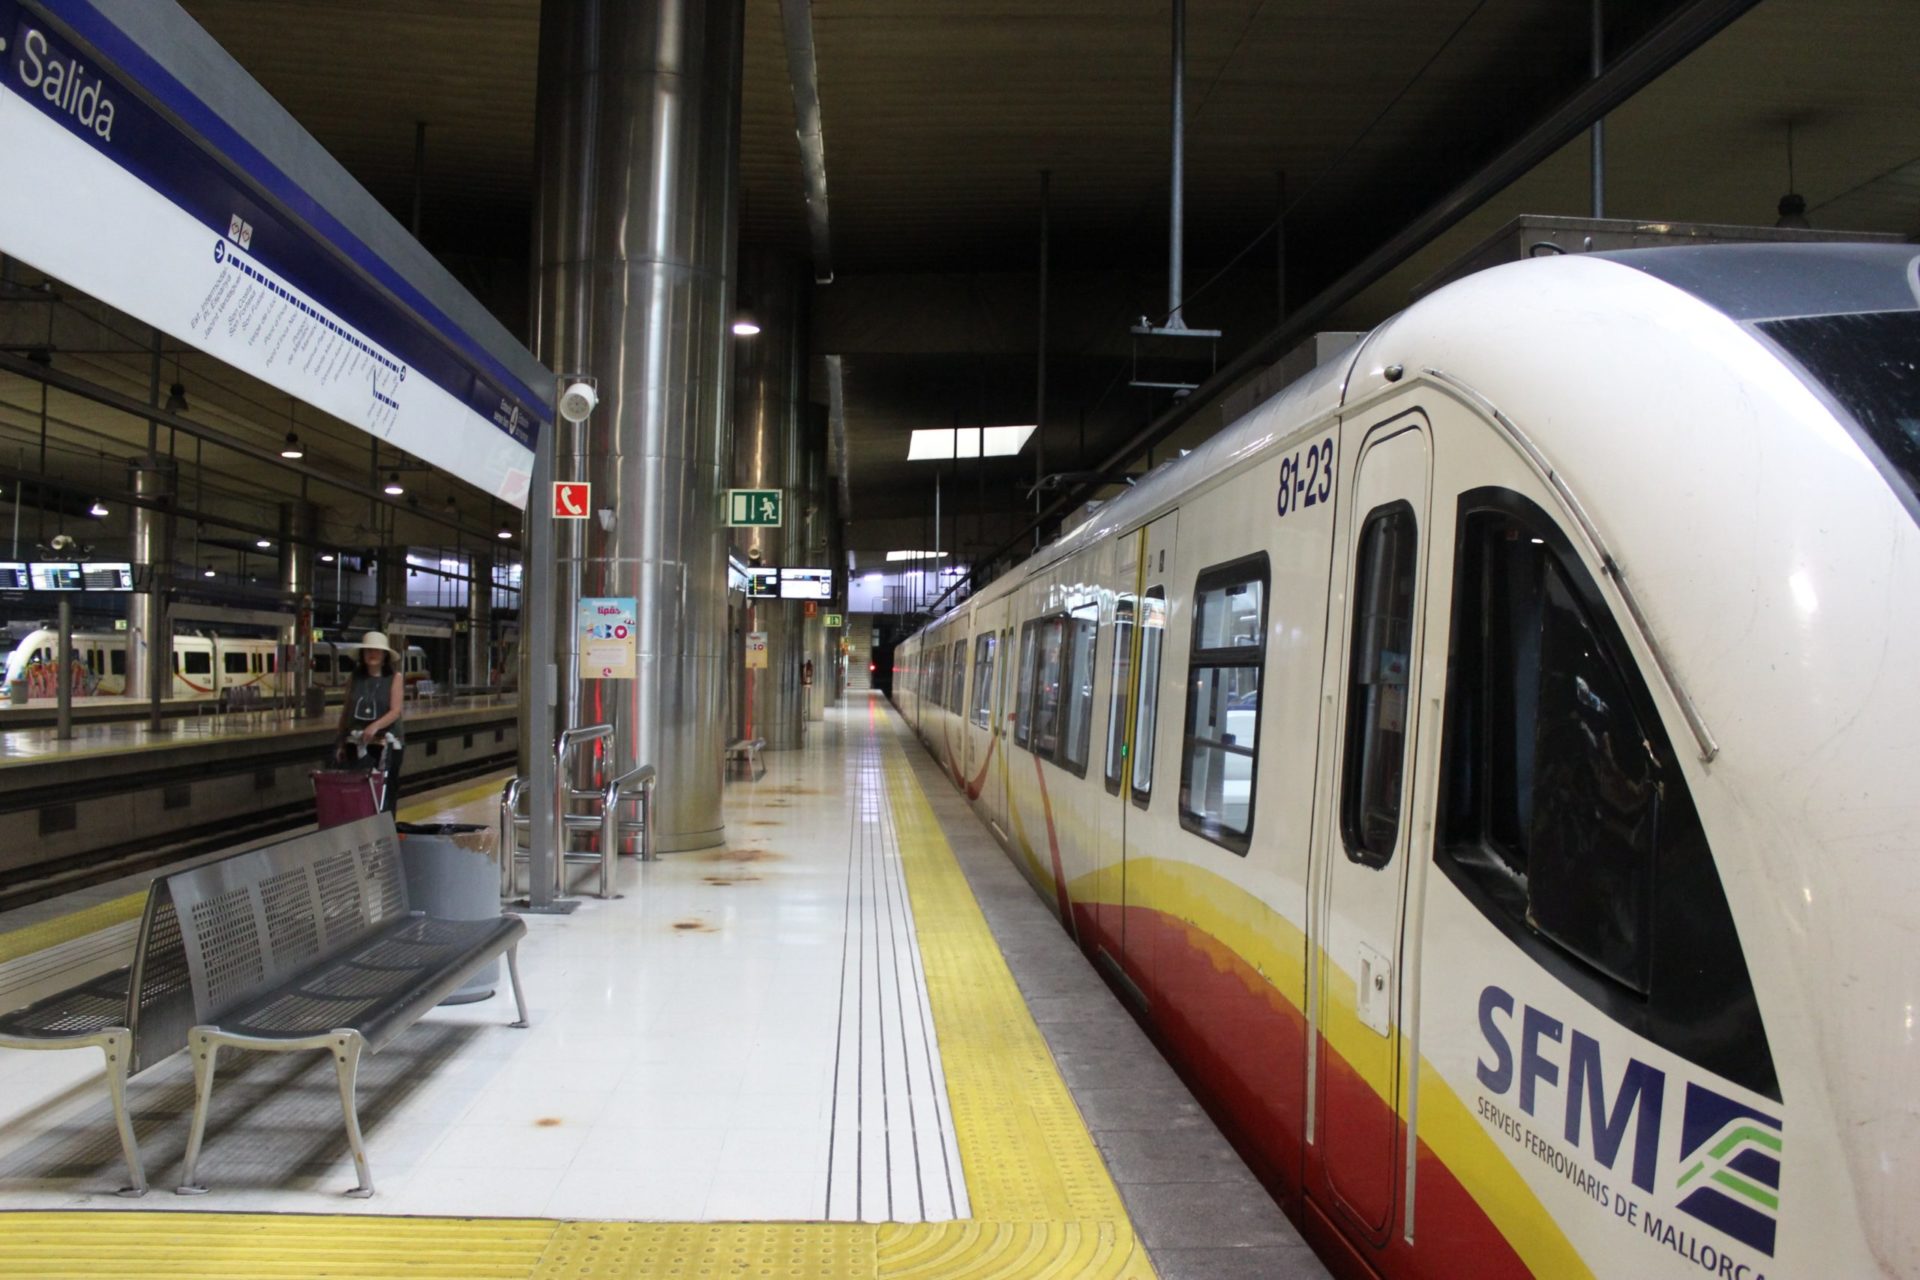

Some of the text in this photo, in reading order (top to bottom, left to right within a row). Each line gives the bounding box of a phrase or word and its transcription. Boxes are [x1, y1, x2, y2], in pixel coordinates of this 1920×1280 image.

[20, 29, 115, 142] Salida
[1277, 437, 1333, 517] 81-23
[1476, 985, 1666, 1195] SFM
[1476, 1096, 1767, 1280] SERVEIS FERROVIARIS DE MALLORC
